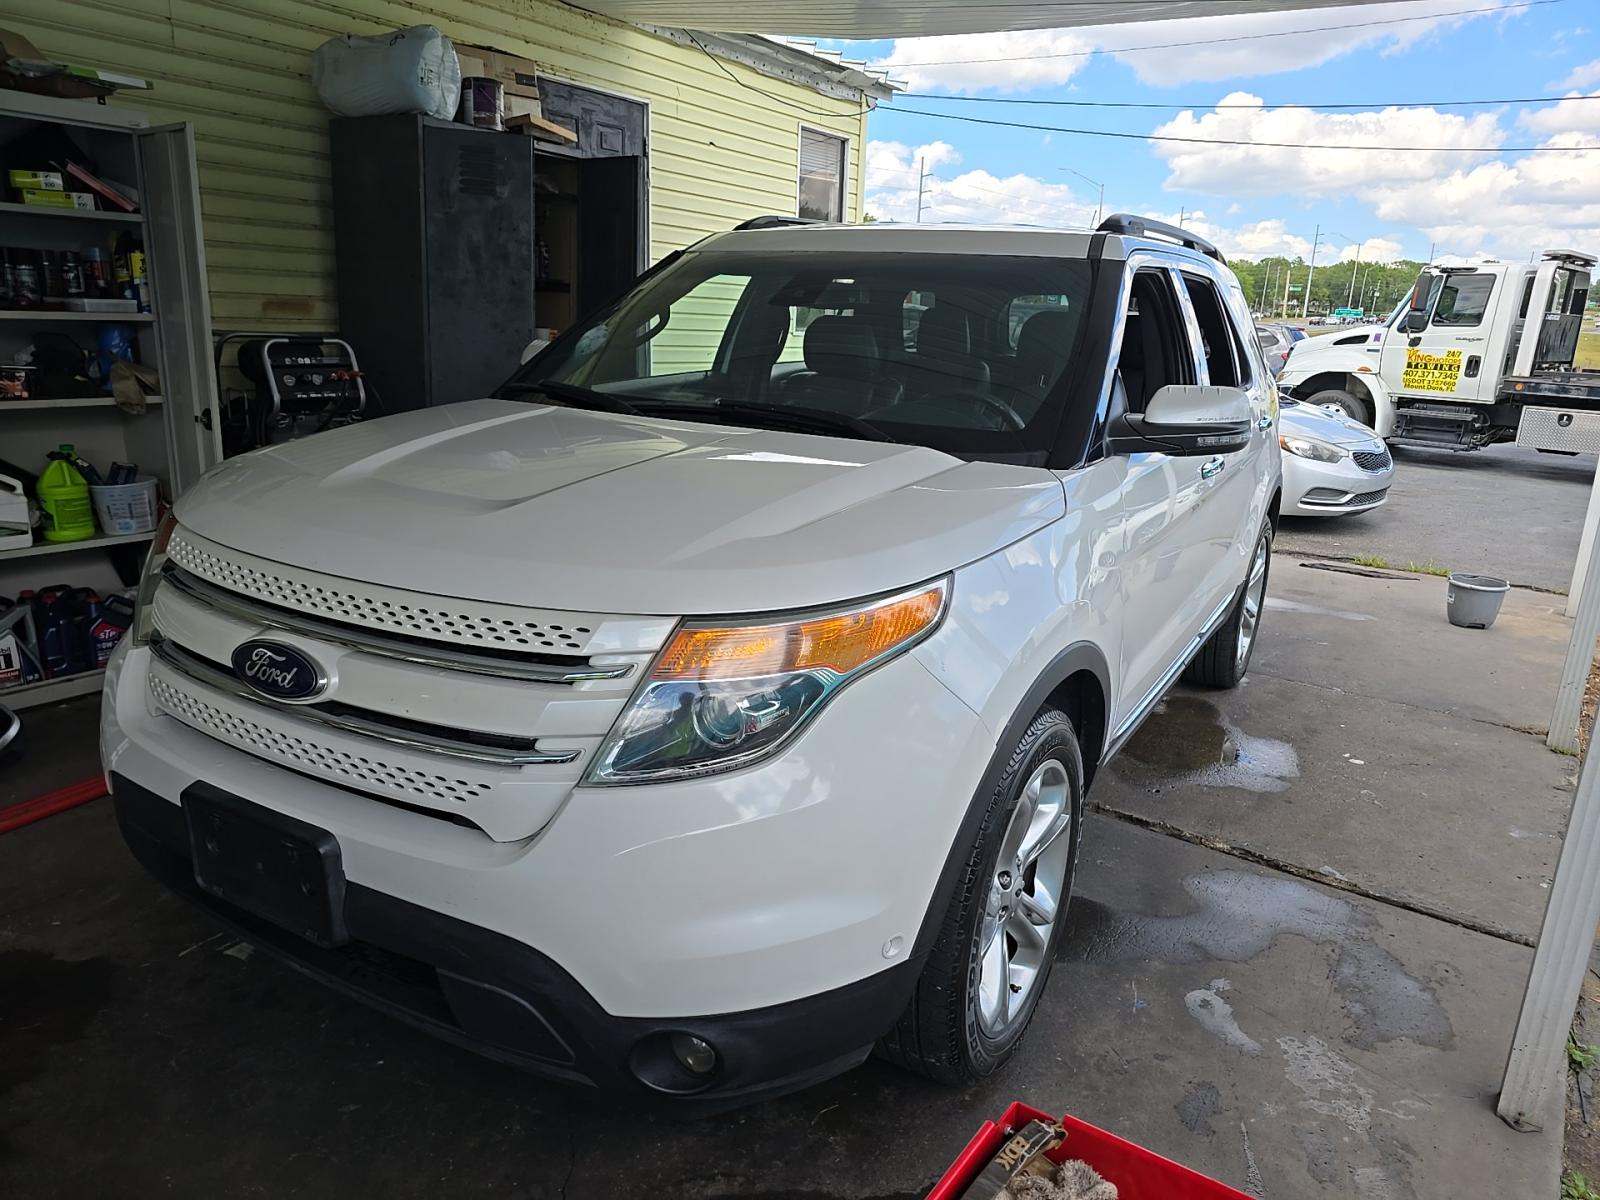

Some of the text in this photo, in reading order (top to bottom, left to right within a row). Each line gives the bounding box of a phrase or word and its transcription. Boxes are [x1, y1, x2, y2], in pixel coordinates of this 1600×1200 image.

[1408, 353, 1433, 362] KING
[1446, 350, 1462, 358] 24/7
[1411, 362, 1460, 371] TOWING
[1403, 370, 1458, 380] 407.371.7345
[245, 648, 298, 688] Ford
[994, 1135, 1029, 1171] BDK
